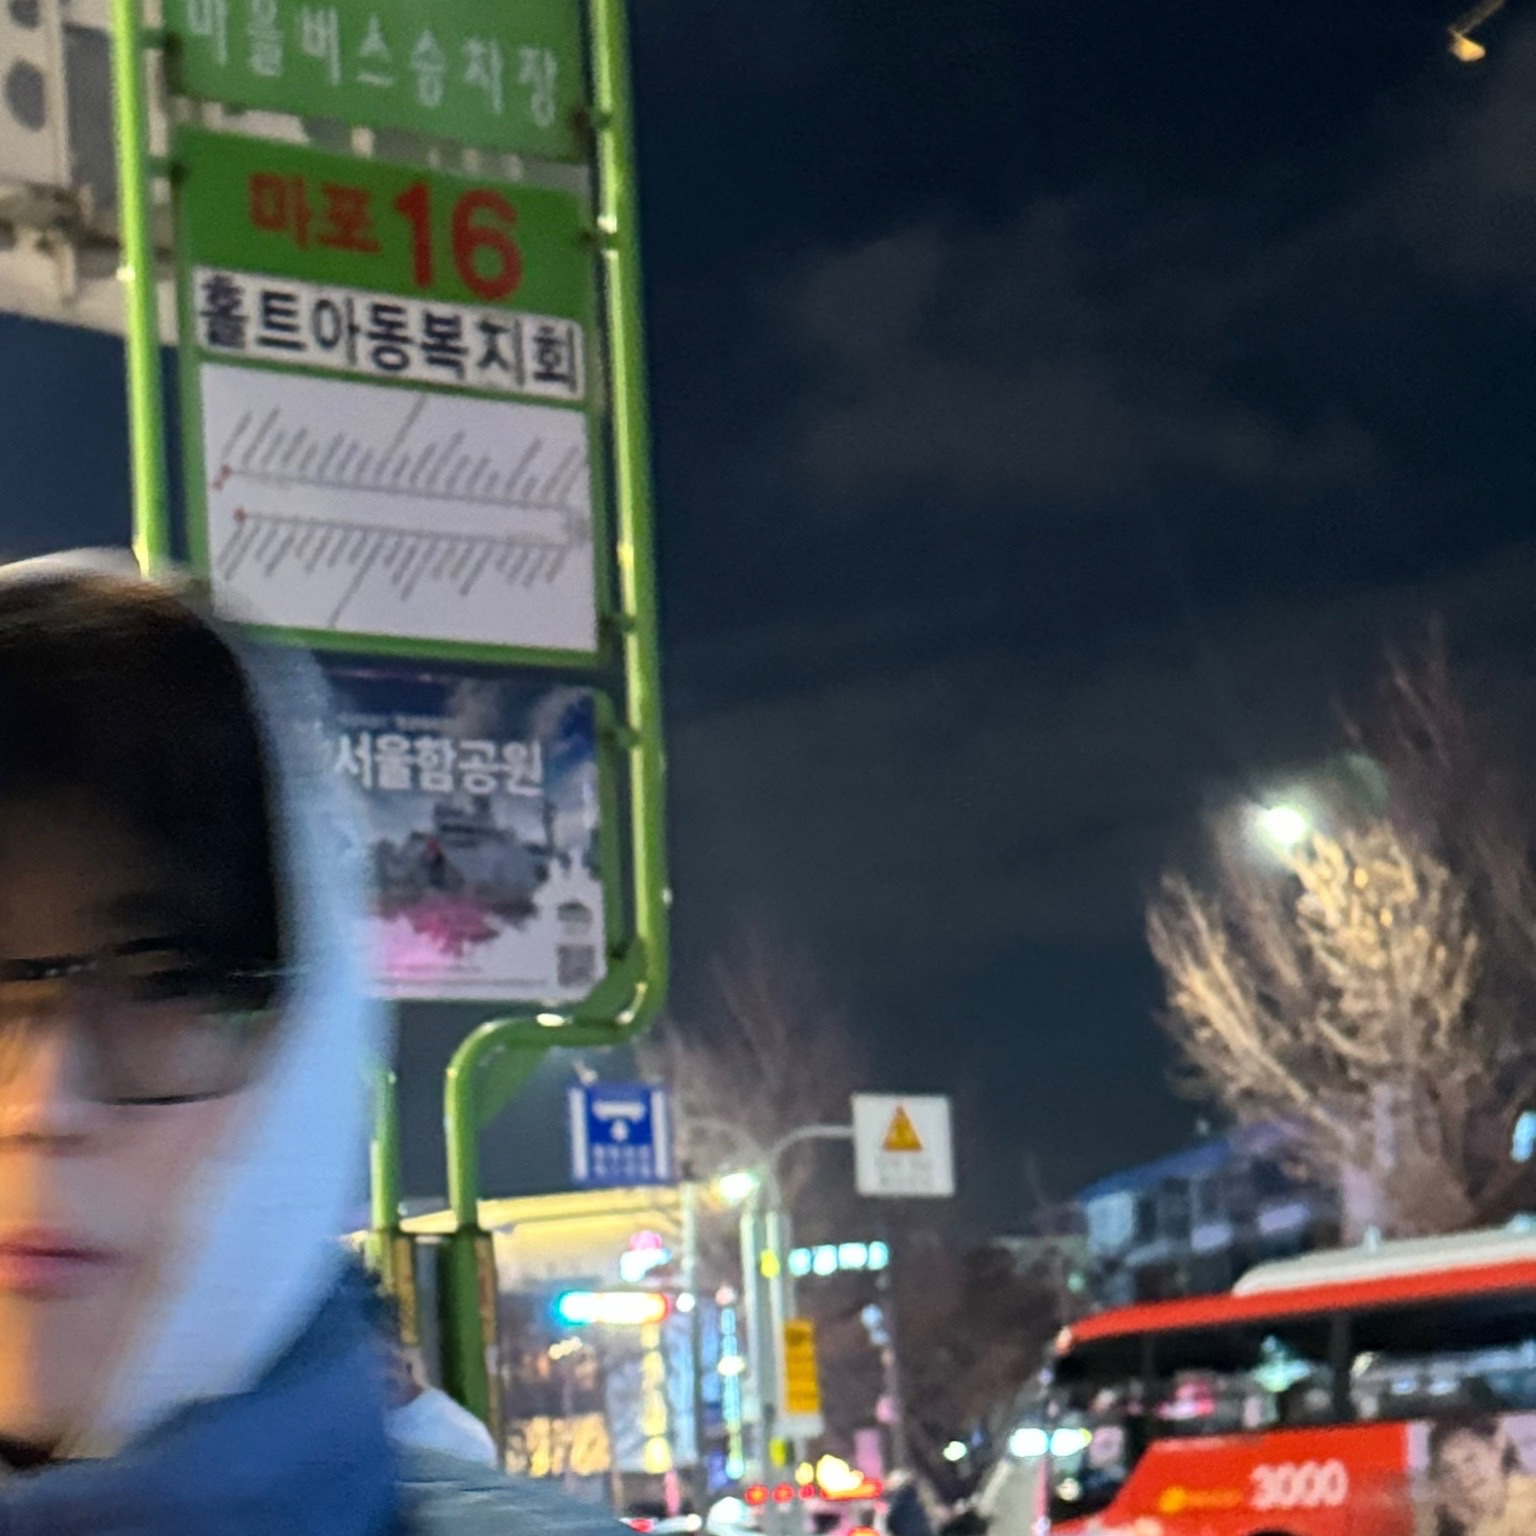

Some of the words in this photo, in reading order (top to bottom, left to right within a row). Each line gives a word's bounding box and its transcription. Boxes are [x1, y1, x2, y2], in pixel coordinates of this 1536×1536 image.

[200, 273, 578, 393] 홀트아동복지회
[333, 731, 545, 797] 서울함공원
[1249, 1457, 1348, 1512] 3000
